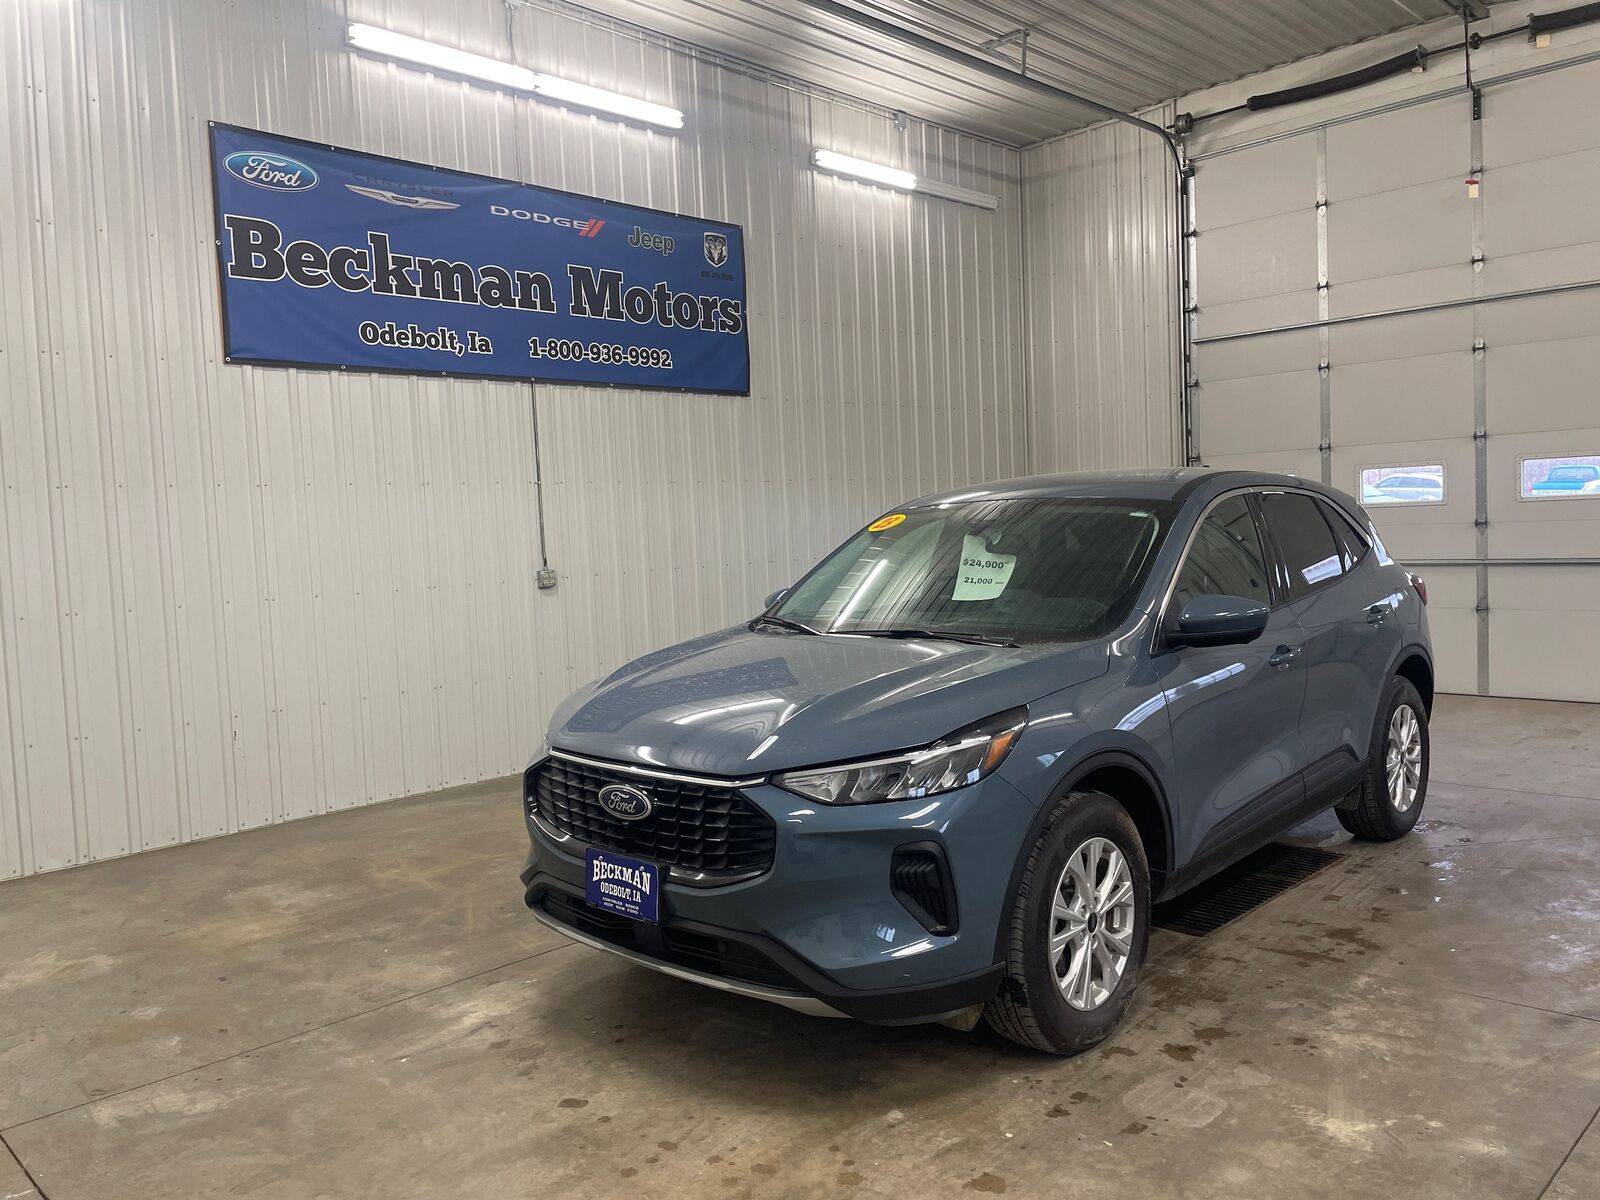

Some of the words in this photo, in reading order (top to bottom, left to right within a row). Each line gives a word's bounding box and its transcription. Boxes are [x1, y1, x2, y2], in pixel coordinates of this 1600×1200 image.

[242, 156, 302, 188] Ford
[490, 205, 590, 231] DODGE
[627, 225, 675, 256] Jeep
[224, 213, 557, 313] Beckman
[567, 263, 743, 334] Motors
[700, 270, 734, 281] RAM
[359, 320, 465, 357] Odebolt,
[467, 331, 493, 354] Ia
[528, 337, 673, 369] 1-800-936-9992
[963, 576, 993, 585] 21,000
[608, 791, 637, 814] Ford
[593, 859, 651, 895] BECKMAN
[600, 881, 632, 901] ODEBOLT,
[633, 889, 642, 902] IA
